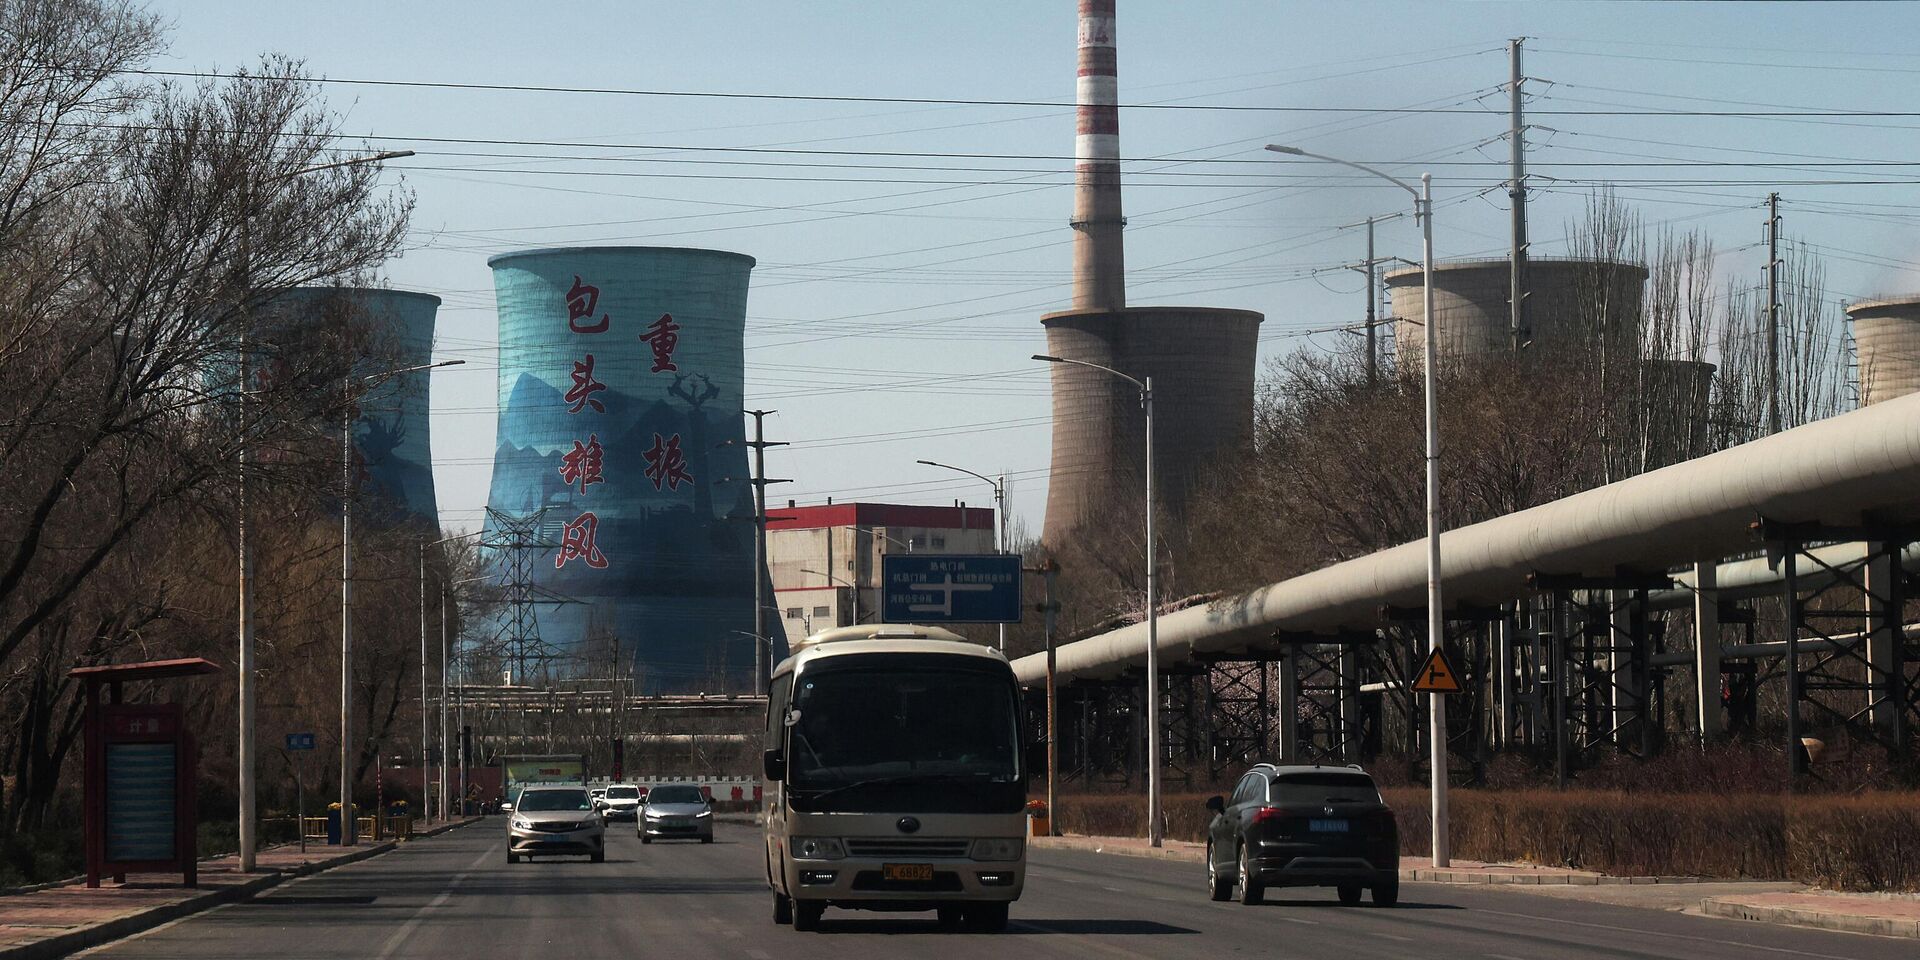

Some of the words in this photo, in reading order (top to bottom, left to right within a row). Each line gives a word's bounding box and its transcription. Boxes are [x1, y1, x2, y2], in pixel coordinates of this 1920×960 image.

[555, 274, 610, 570] 包头雄风
[638, 312, 695, 491] 重振
